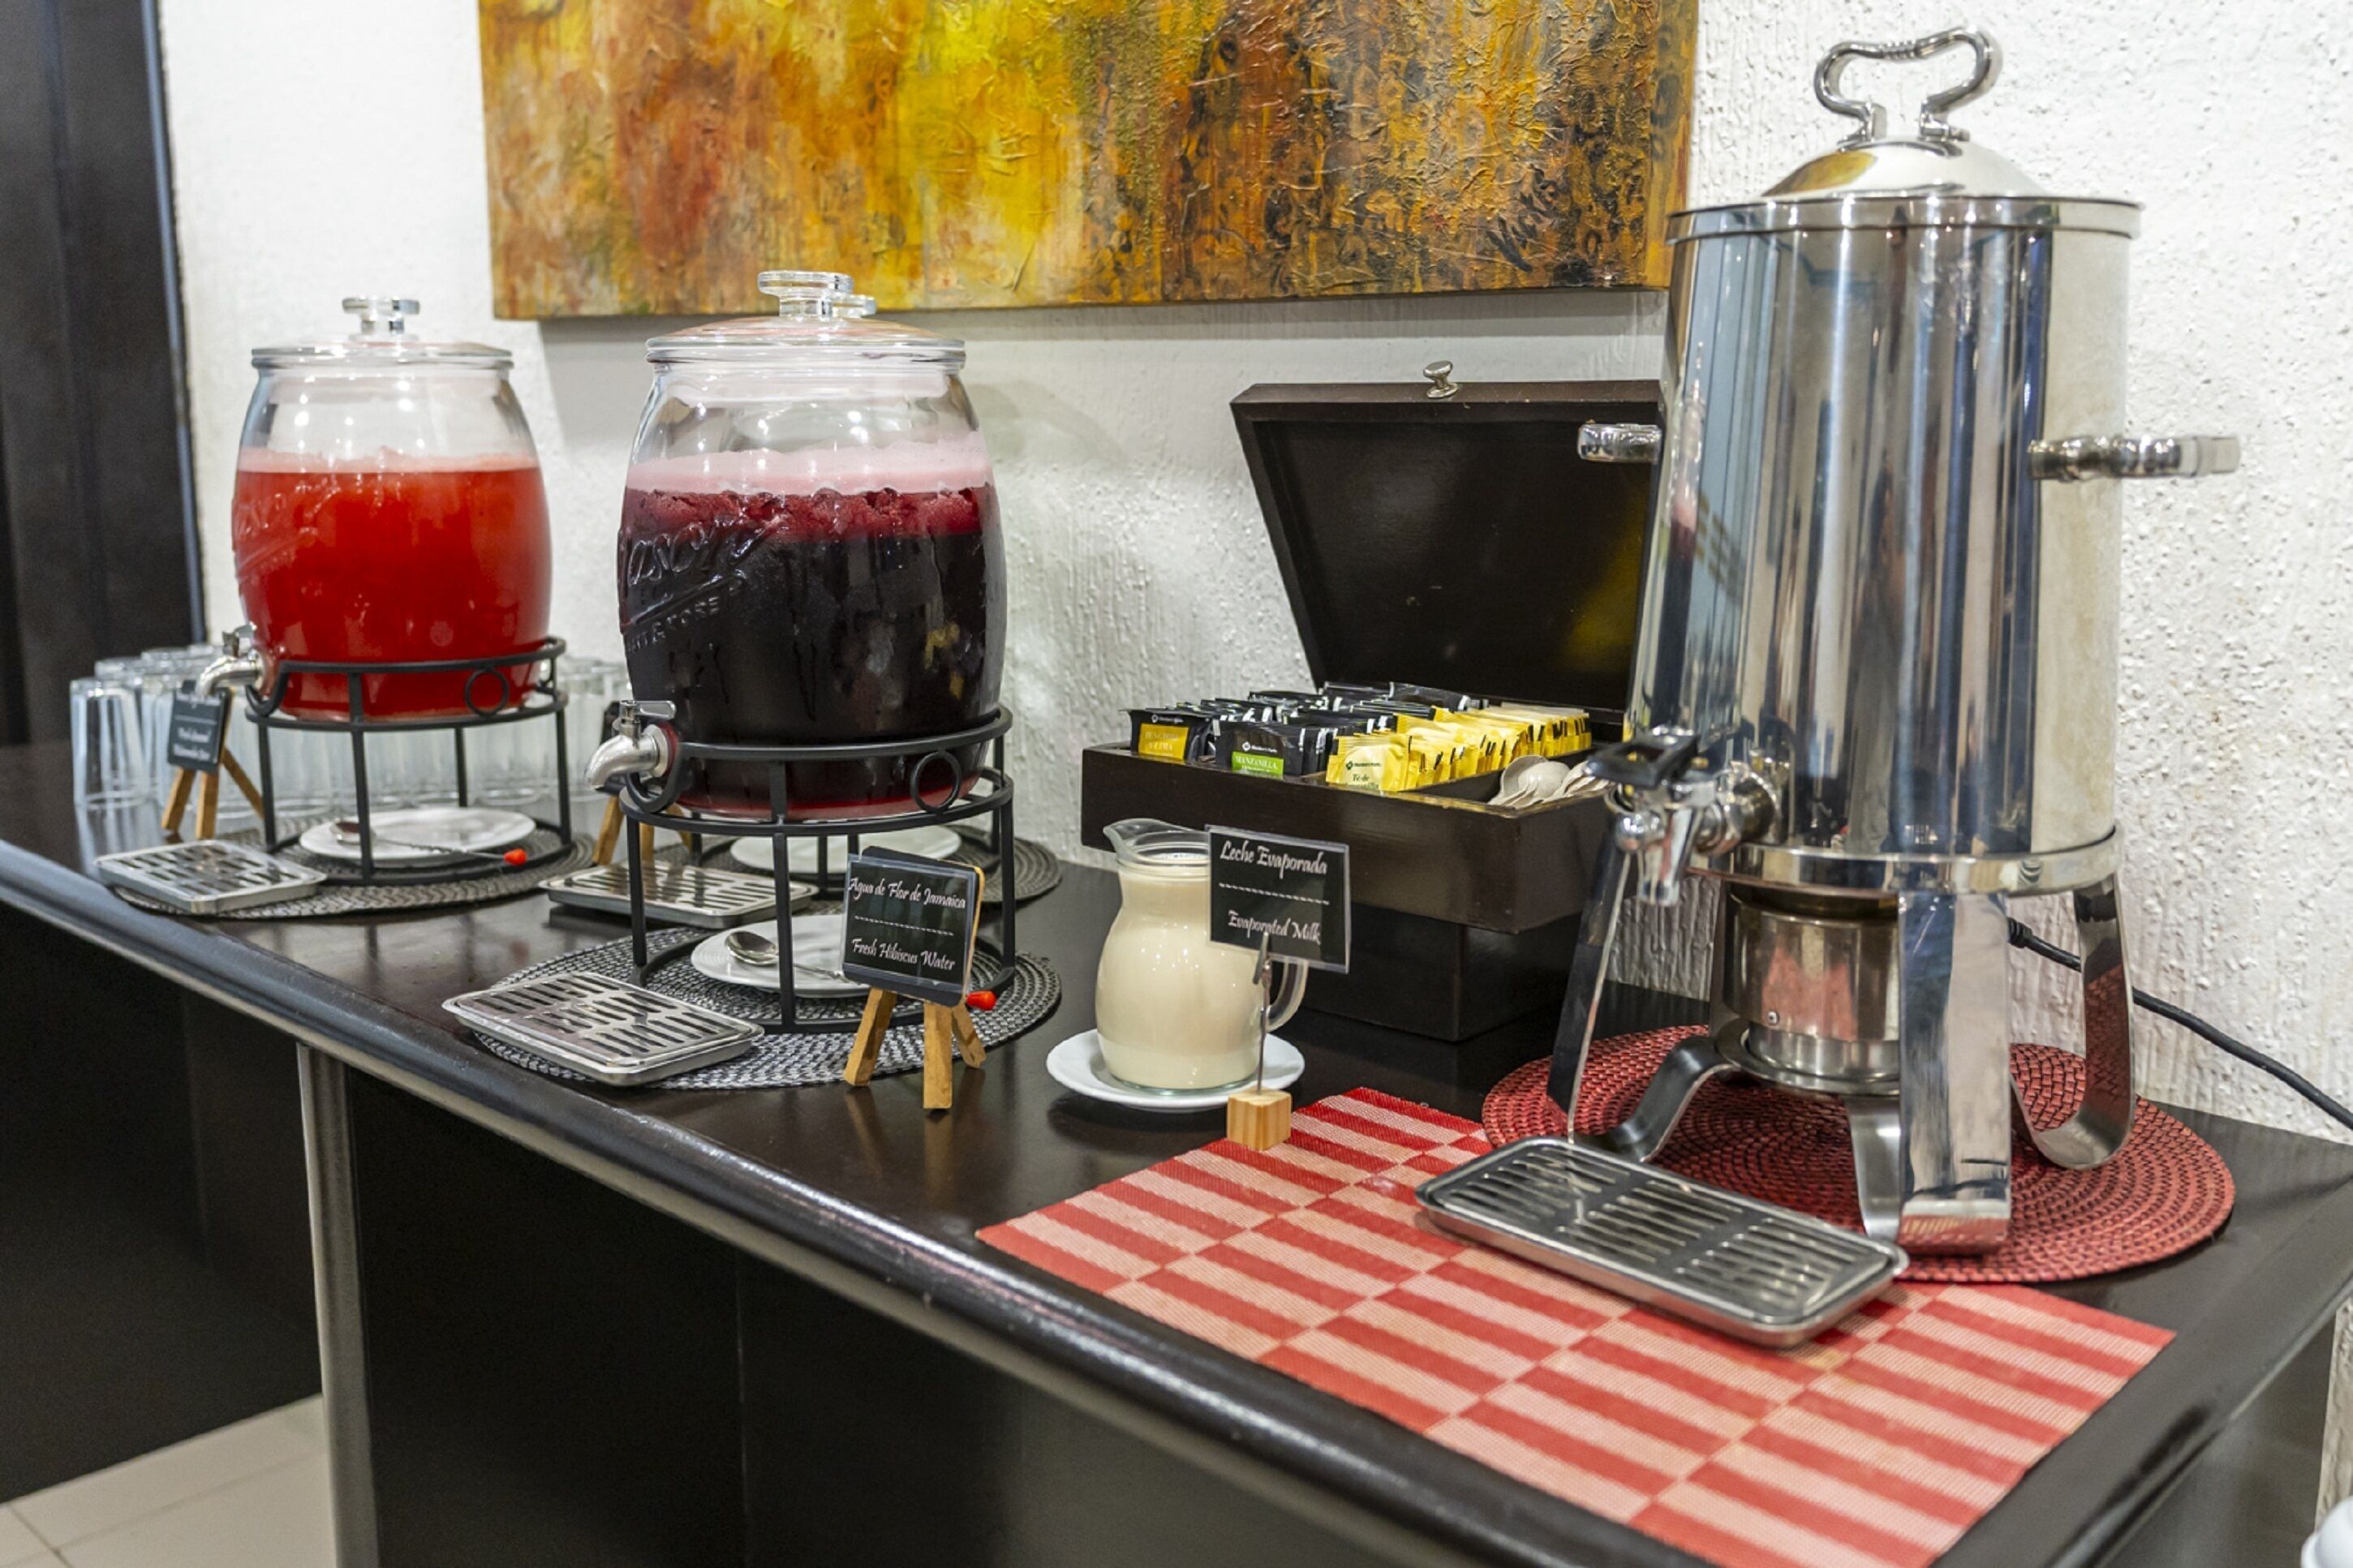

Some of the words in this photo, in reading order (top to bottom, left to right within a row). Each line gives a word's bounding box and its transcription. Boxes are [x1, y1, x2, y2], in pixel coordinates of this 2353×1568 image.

[1235, 755, 1279, 770] MANZANILLA
[1220, 840, 1254, 863] Leche
[1257, 845, 1328, 880] Evaporada
[847, 877, 874, 901] Agua
[874, 878, 886, 896] de
[888, 880, 910, 900] Flor
[910, 883, 922, 902] de
[923, 888, 966, 909] Jamaica
[1228, 909, 1292, 939] Evaporated
[1292, 921, 1322, 946] Milk
[852, 938, 878, 957] Fresh
[879, 942, 918, 964] Hibiscus
[920, 950, 956, 971] Water
